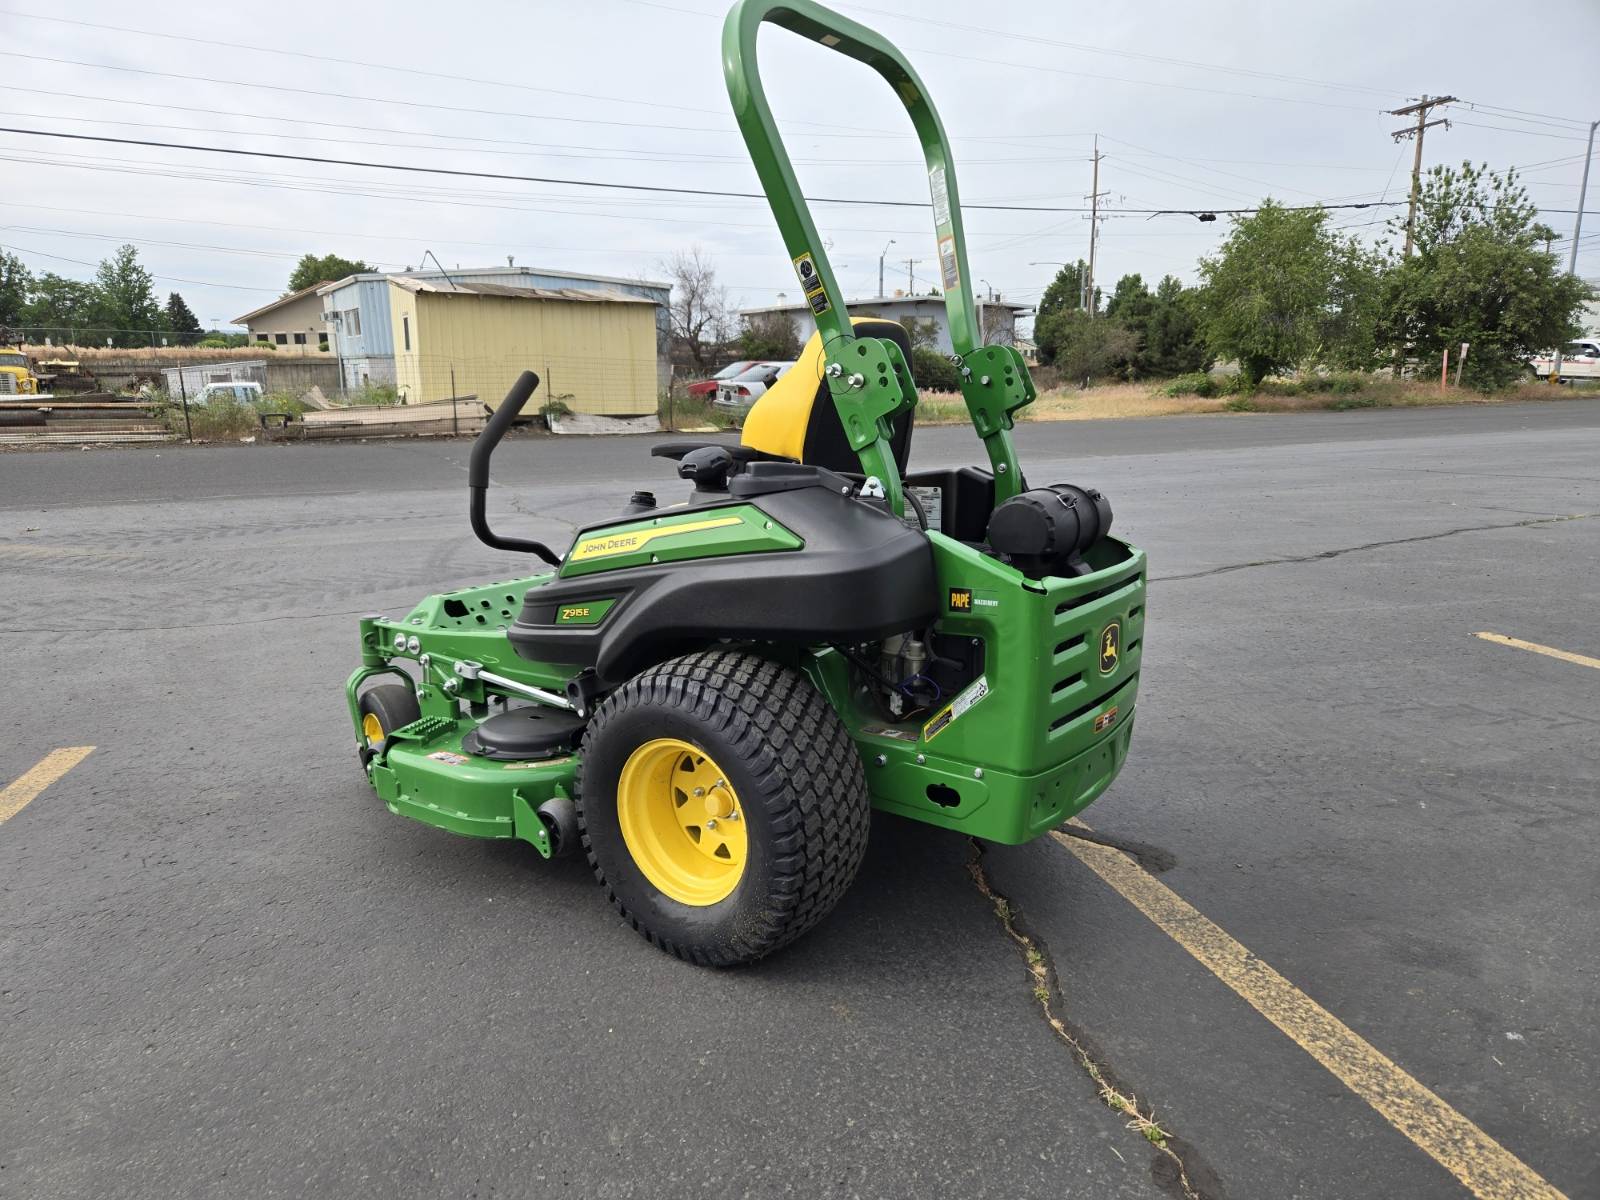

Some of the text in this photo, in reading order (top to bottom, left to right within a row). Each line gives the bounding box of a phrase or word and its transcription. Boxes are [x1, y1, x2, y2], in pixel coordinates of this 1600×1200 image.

[583, 537, 638, 553] JOHN DEERE
[562, 608, 590, 620] Z915E
